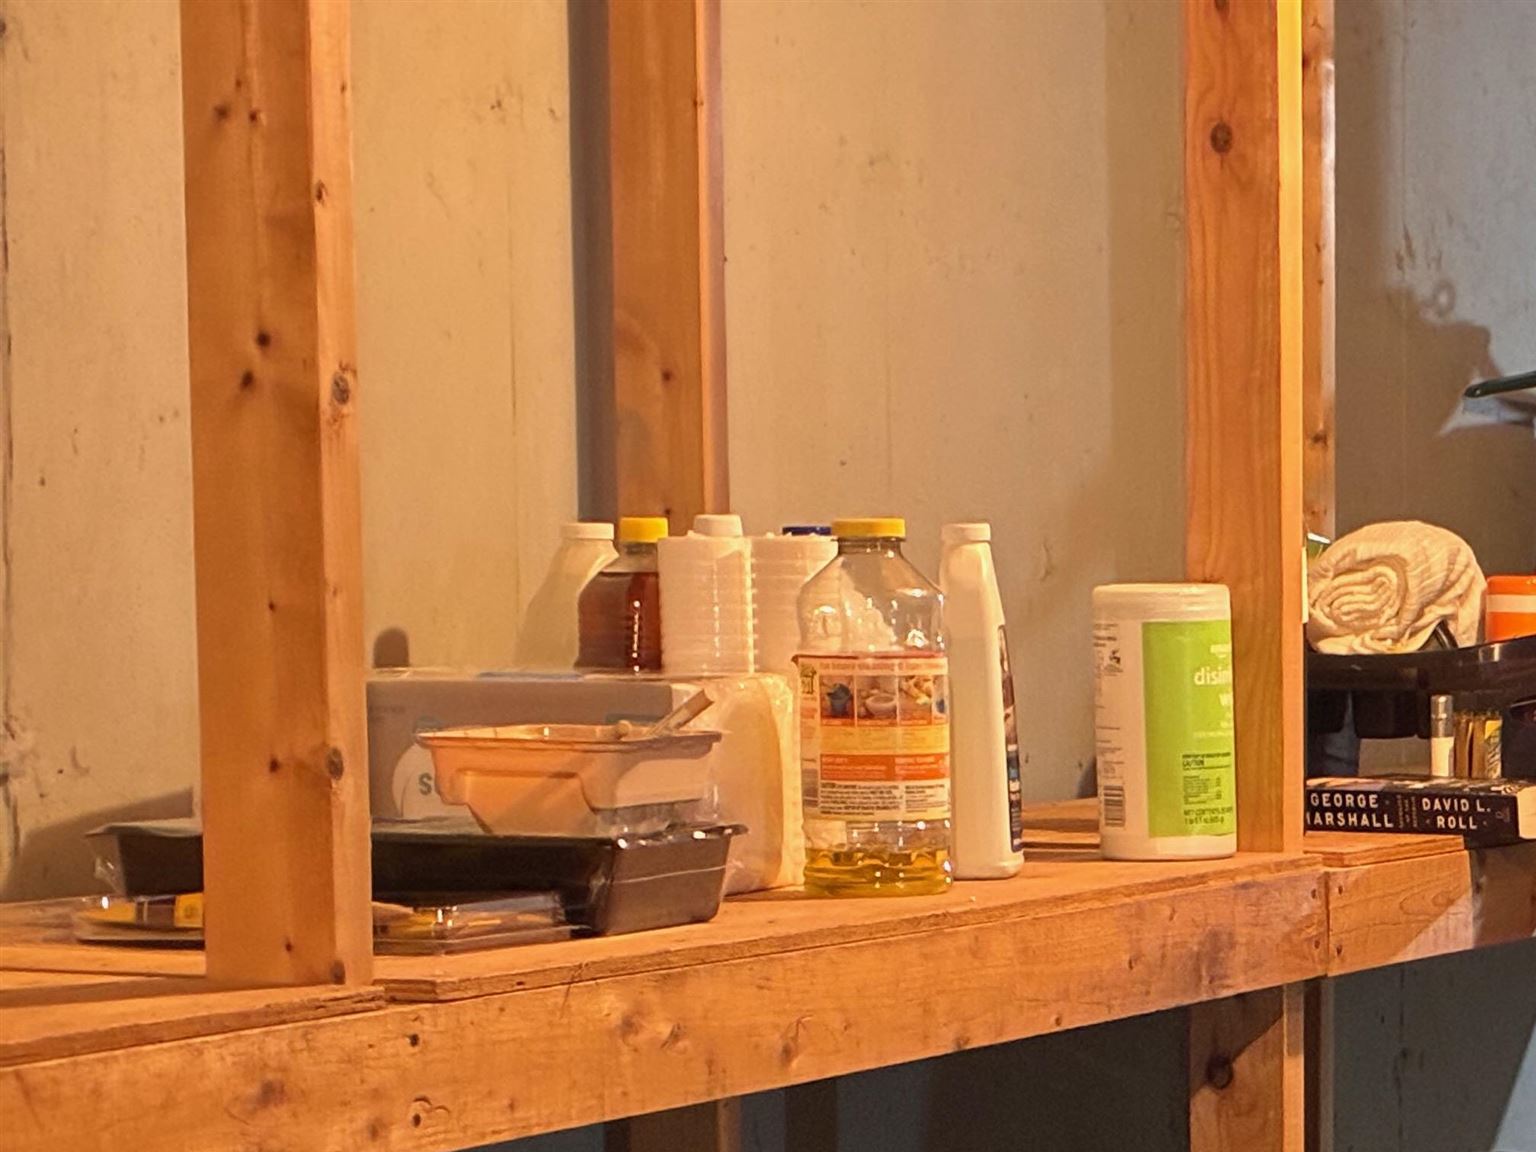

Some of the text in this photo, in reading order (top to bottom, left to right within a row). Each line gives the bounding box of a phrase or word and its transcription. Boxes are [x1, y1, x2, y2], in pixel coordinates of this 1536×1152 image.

[1310, 792, 1379, 809] GEORGE
[1422, 797, 1469, 812] DAVID
[1476, 799, 1491, 813] L.
[1436, 815, 1477, 830] ROLL
